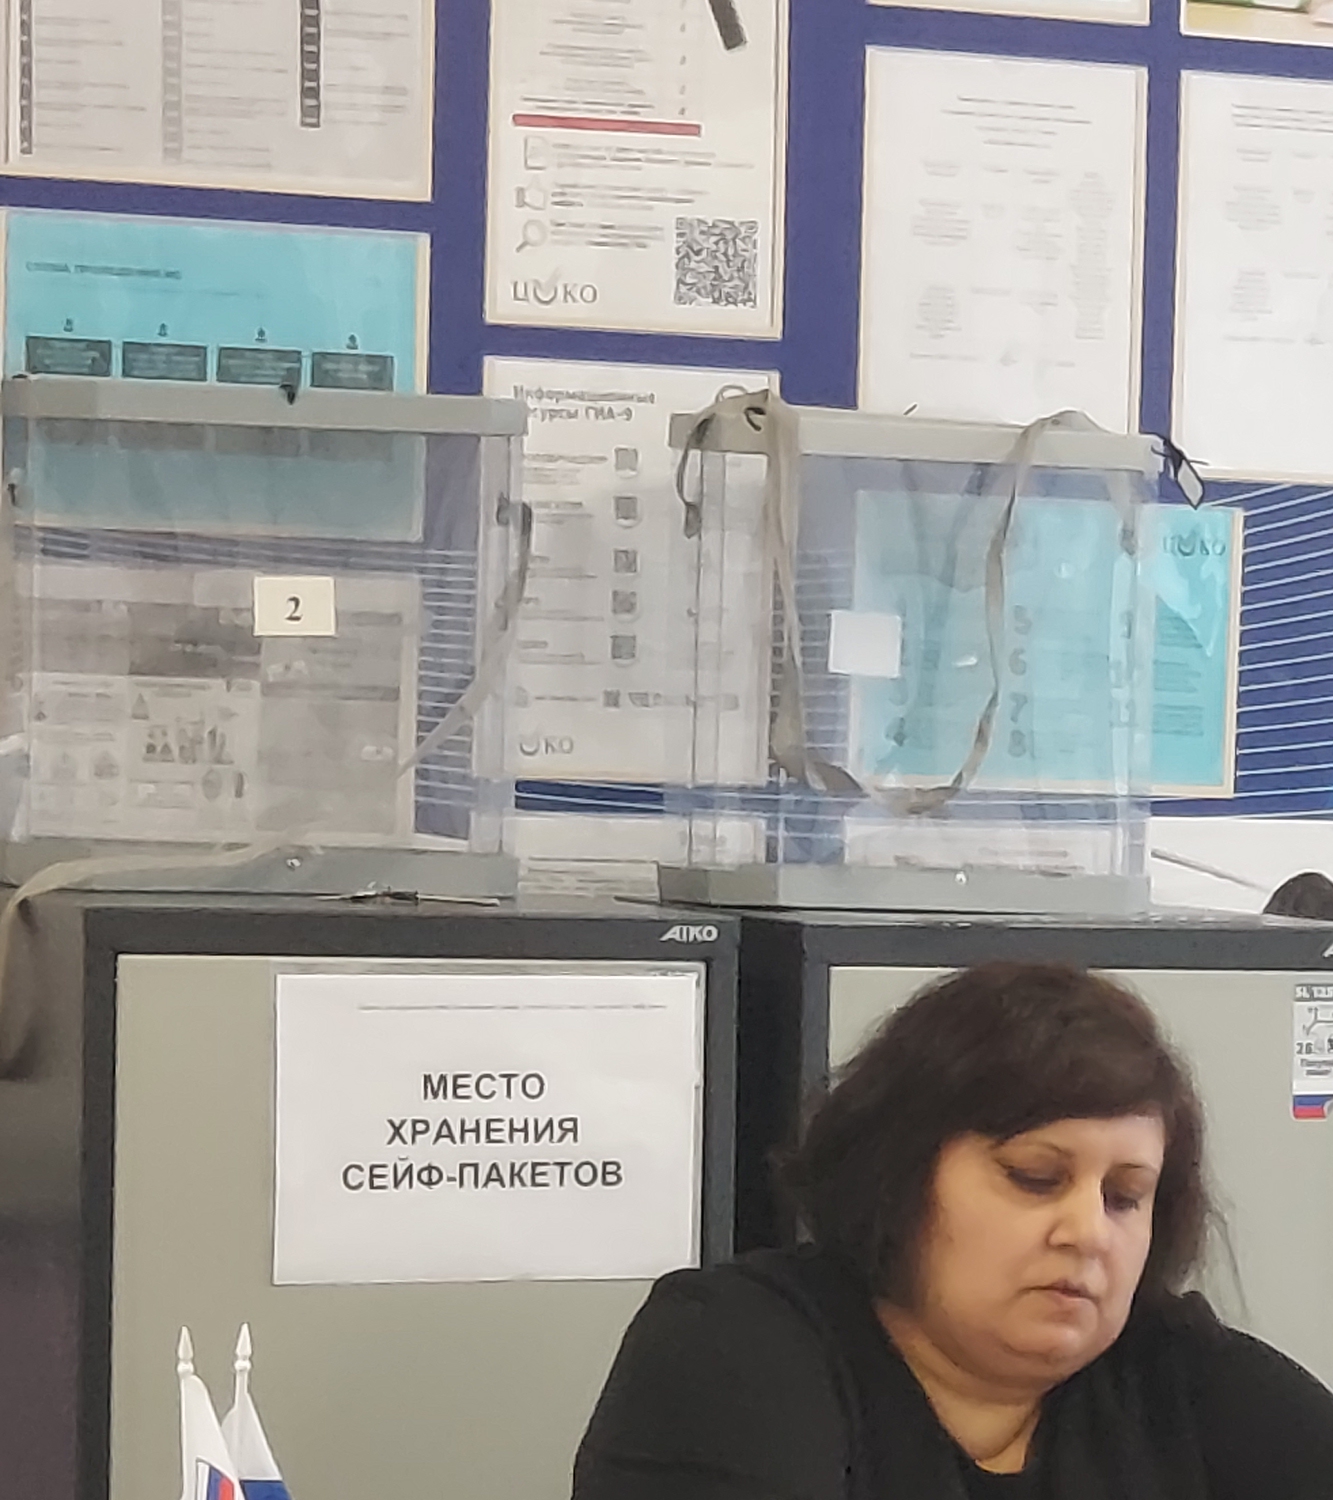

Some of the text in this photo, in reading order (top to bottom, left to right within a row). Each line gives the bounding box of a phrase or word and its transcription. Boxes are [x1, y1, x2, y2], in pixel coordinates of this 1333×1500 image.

[285, 596, 303, 621] 2
[660, 925, 718, 943] AIKO
[423, 1073, 546, 1100] МЕСТО
[386, 1117, 579, 1146] ХРАНЕНИЯ
[342, 1158, 623, 1190] СЕЙФ-ПАКЕТОВ
